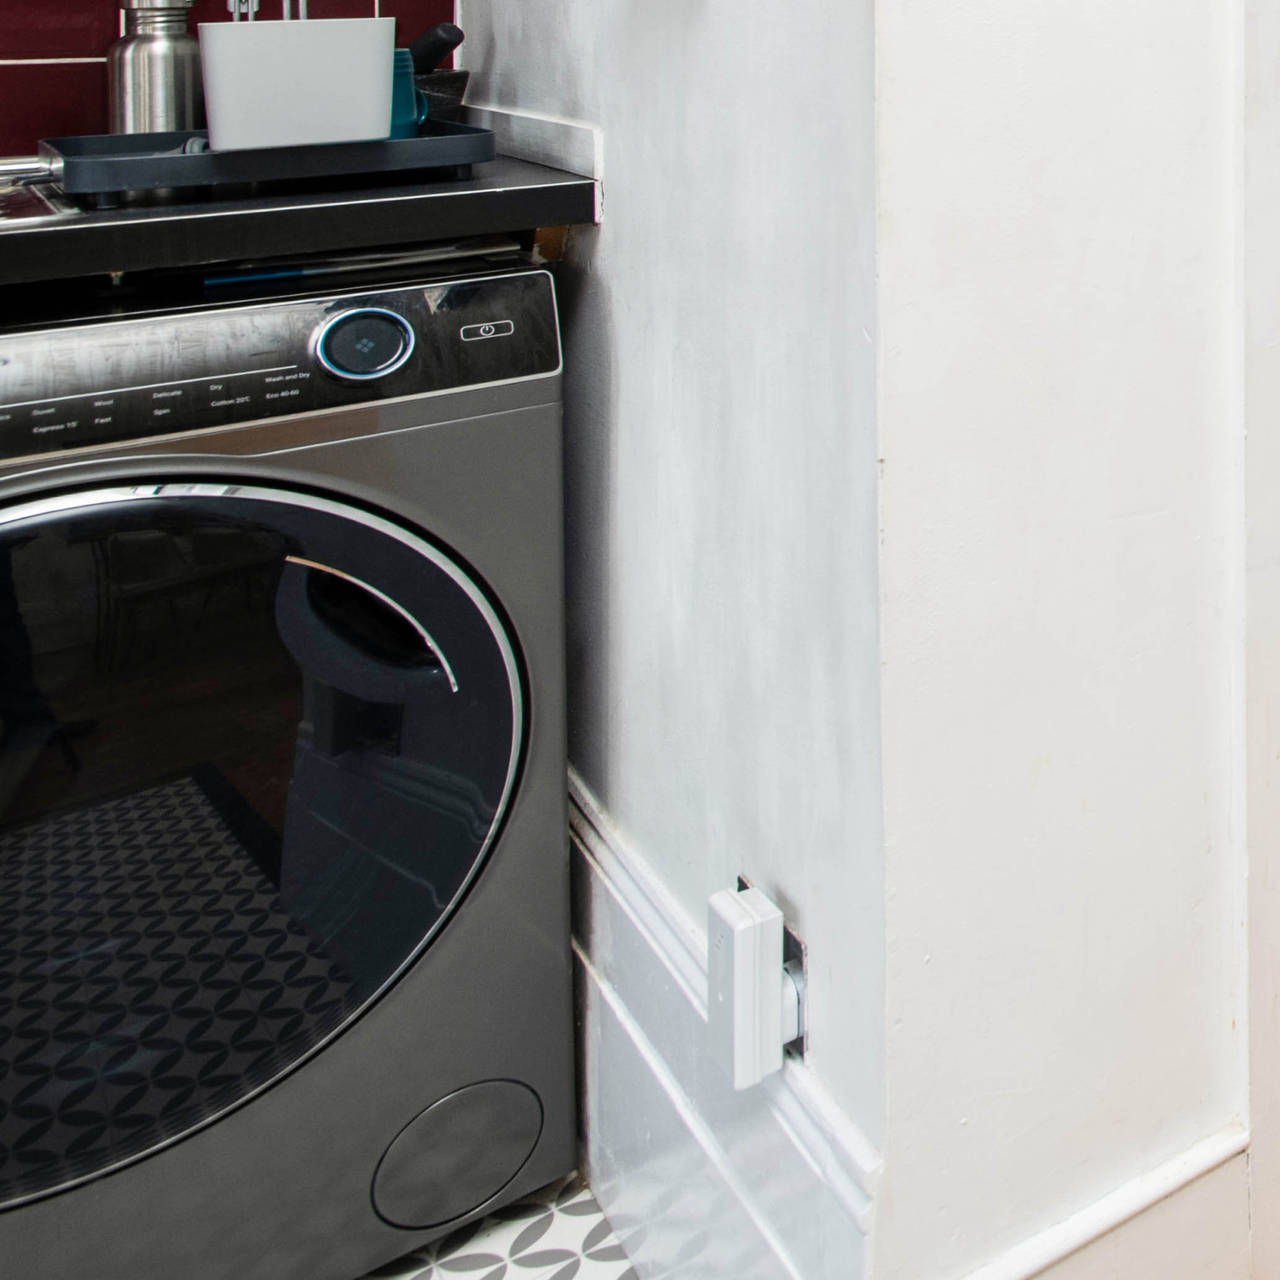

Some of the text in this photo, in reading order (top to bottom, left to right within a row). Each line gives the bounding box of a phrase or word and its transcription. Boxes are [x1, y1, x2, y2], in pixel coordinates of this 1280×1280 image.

[299, 372, 311, 380] Dry
[210, 384, 223, 392] Dry
[153, 389, 183, 399] Delicate
[211, 399, 235, 408] Cotton
[95, 416, 112, 424] Fast
